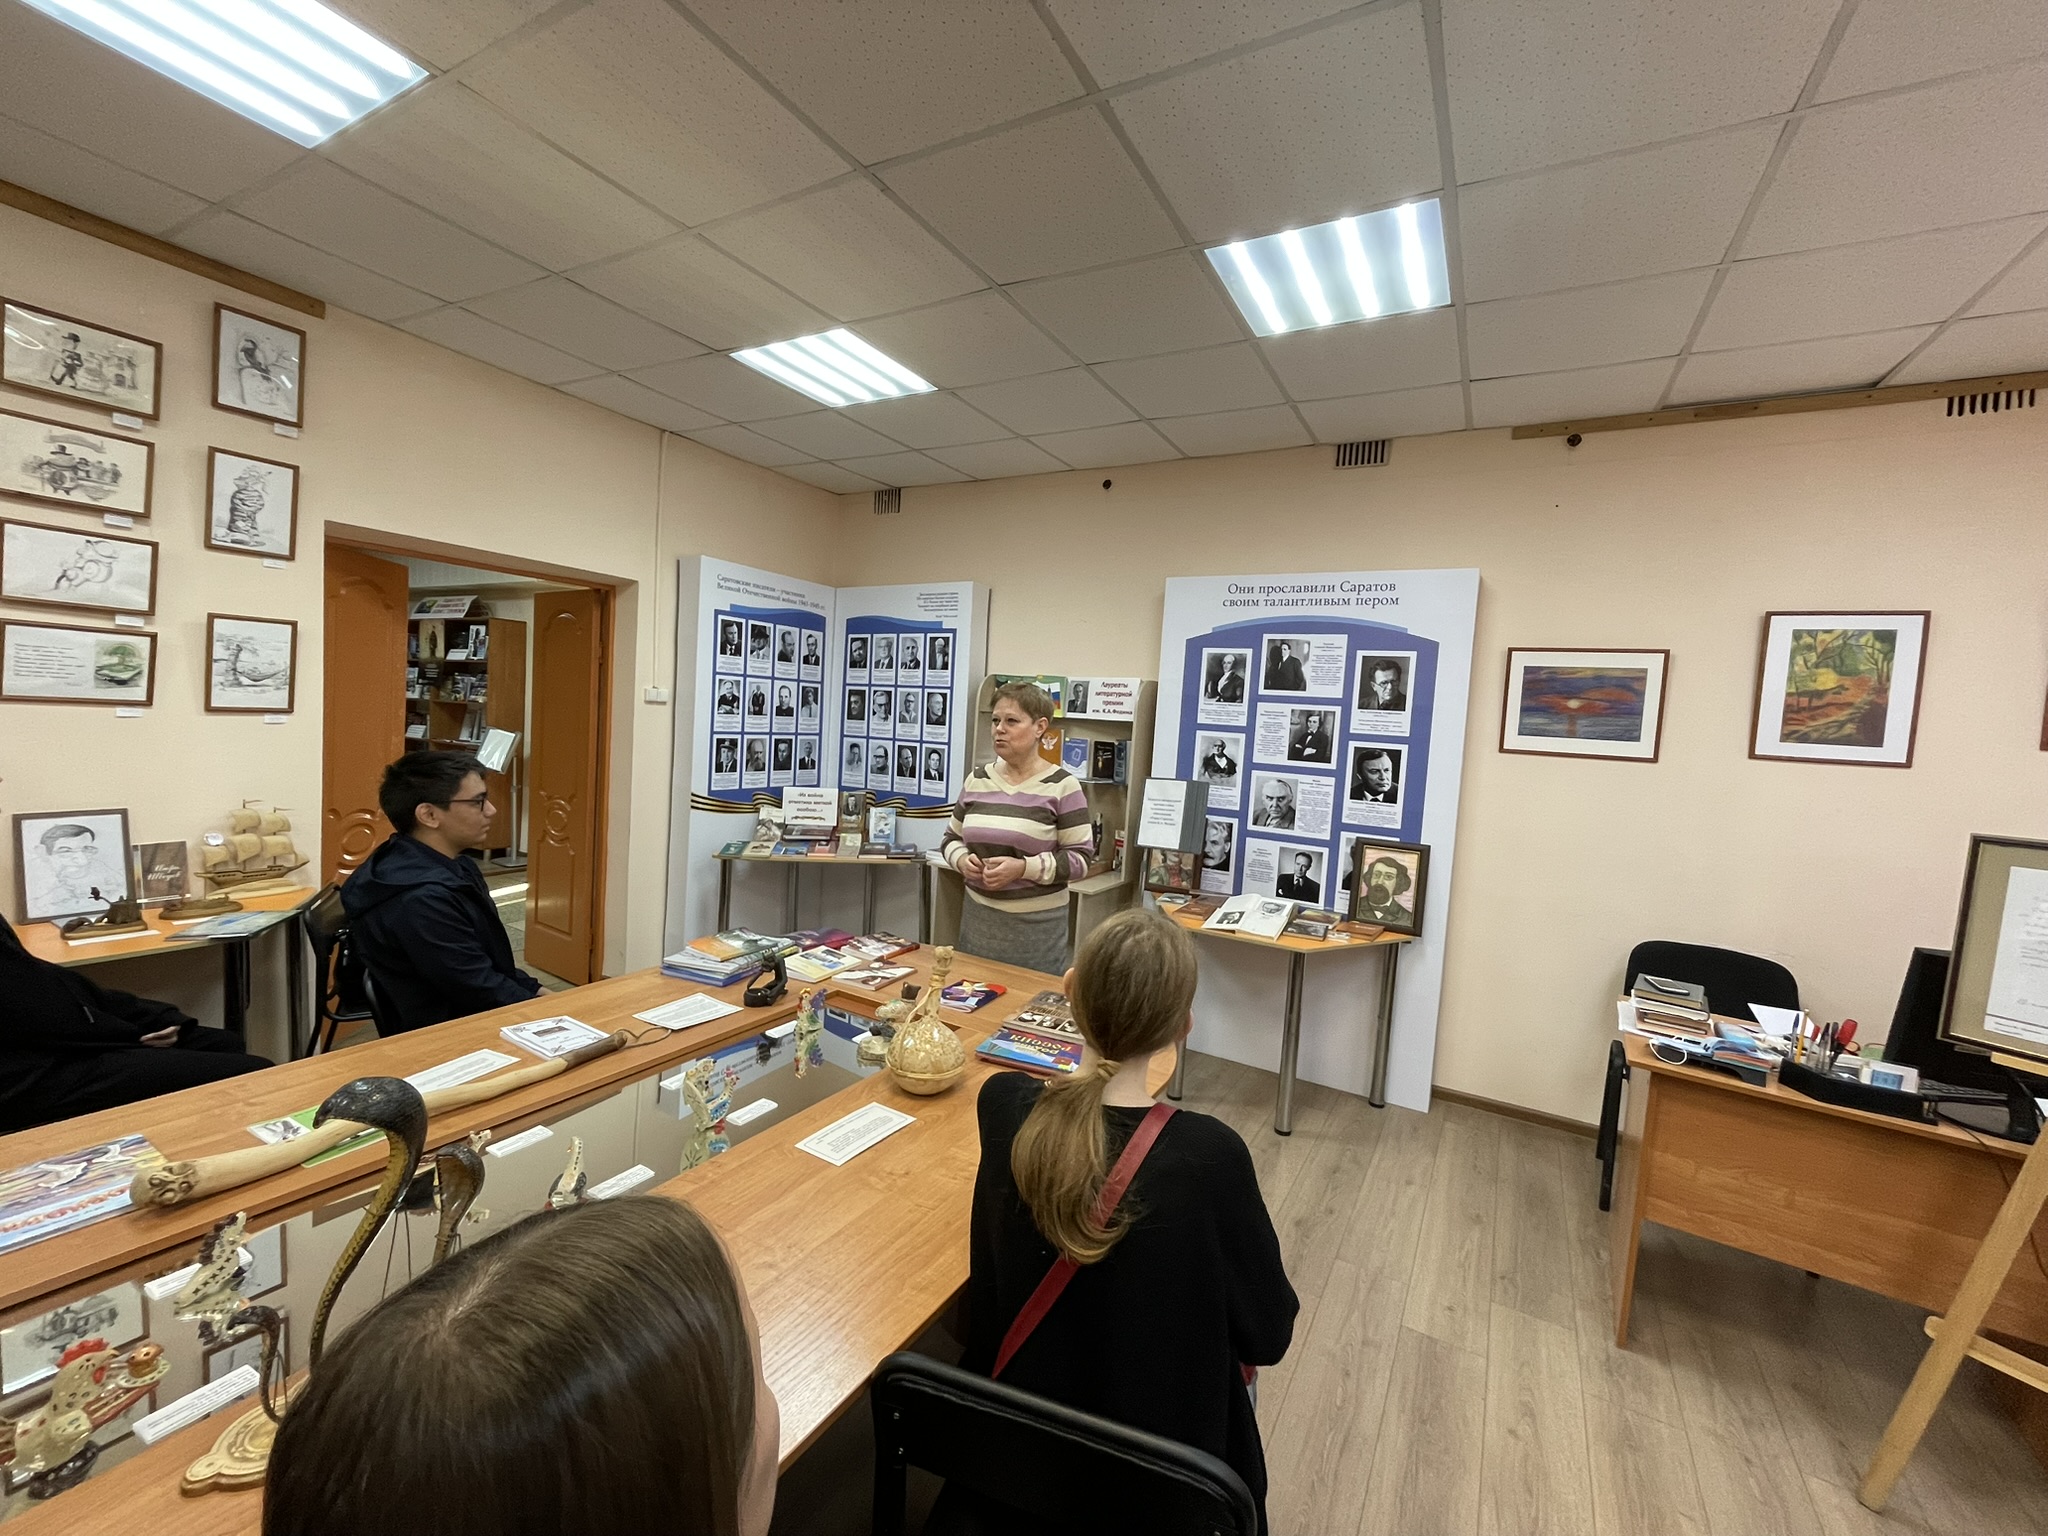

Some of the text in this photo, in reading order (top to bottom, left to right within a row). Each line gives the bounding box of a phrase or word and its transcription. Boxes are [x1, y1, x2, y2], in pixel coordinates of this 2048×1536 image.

[1227, 580, 1396, 597] Они прославили Саратов
[1222, 596, 1400, 609] своим талантливым пером
[1101, 681, 1128, 689] Лауреаты
